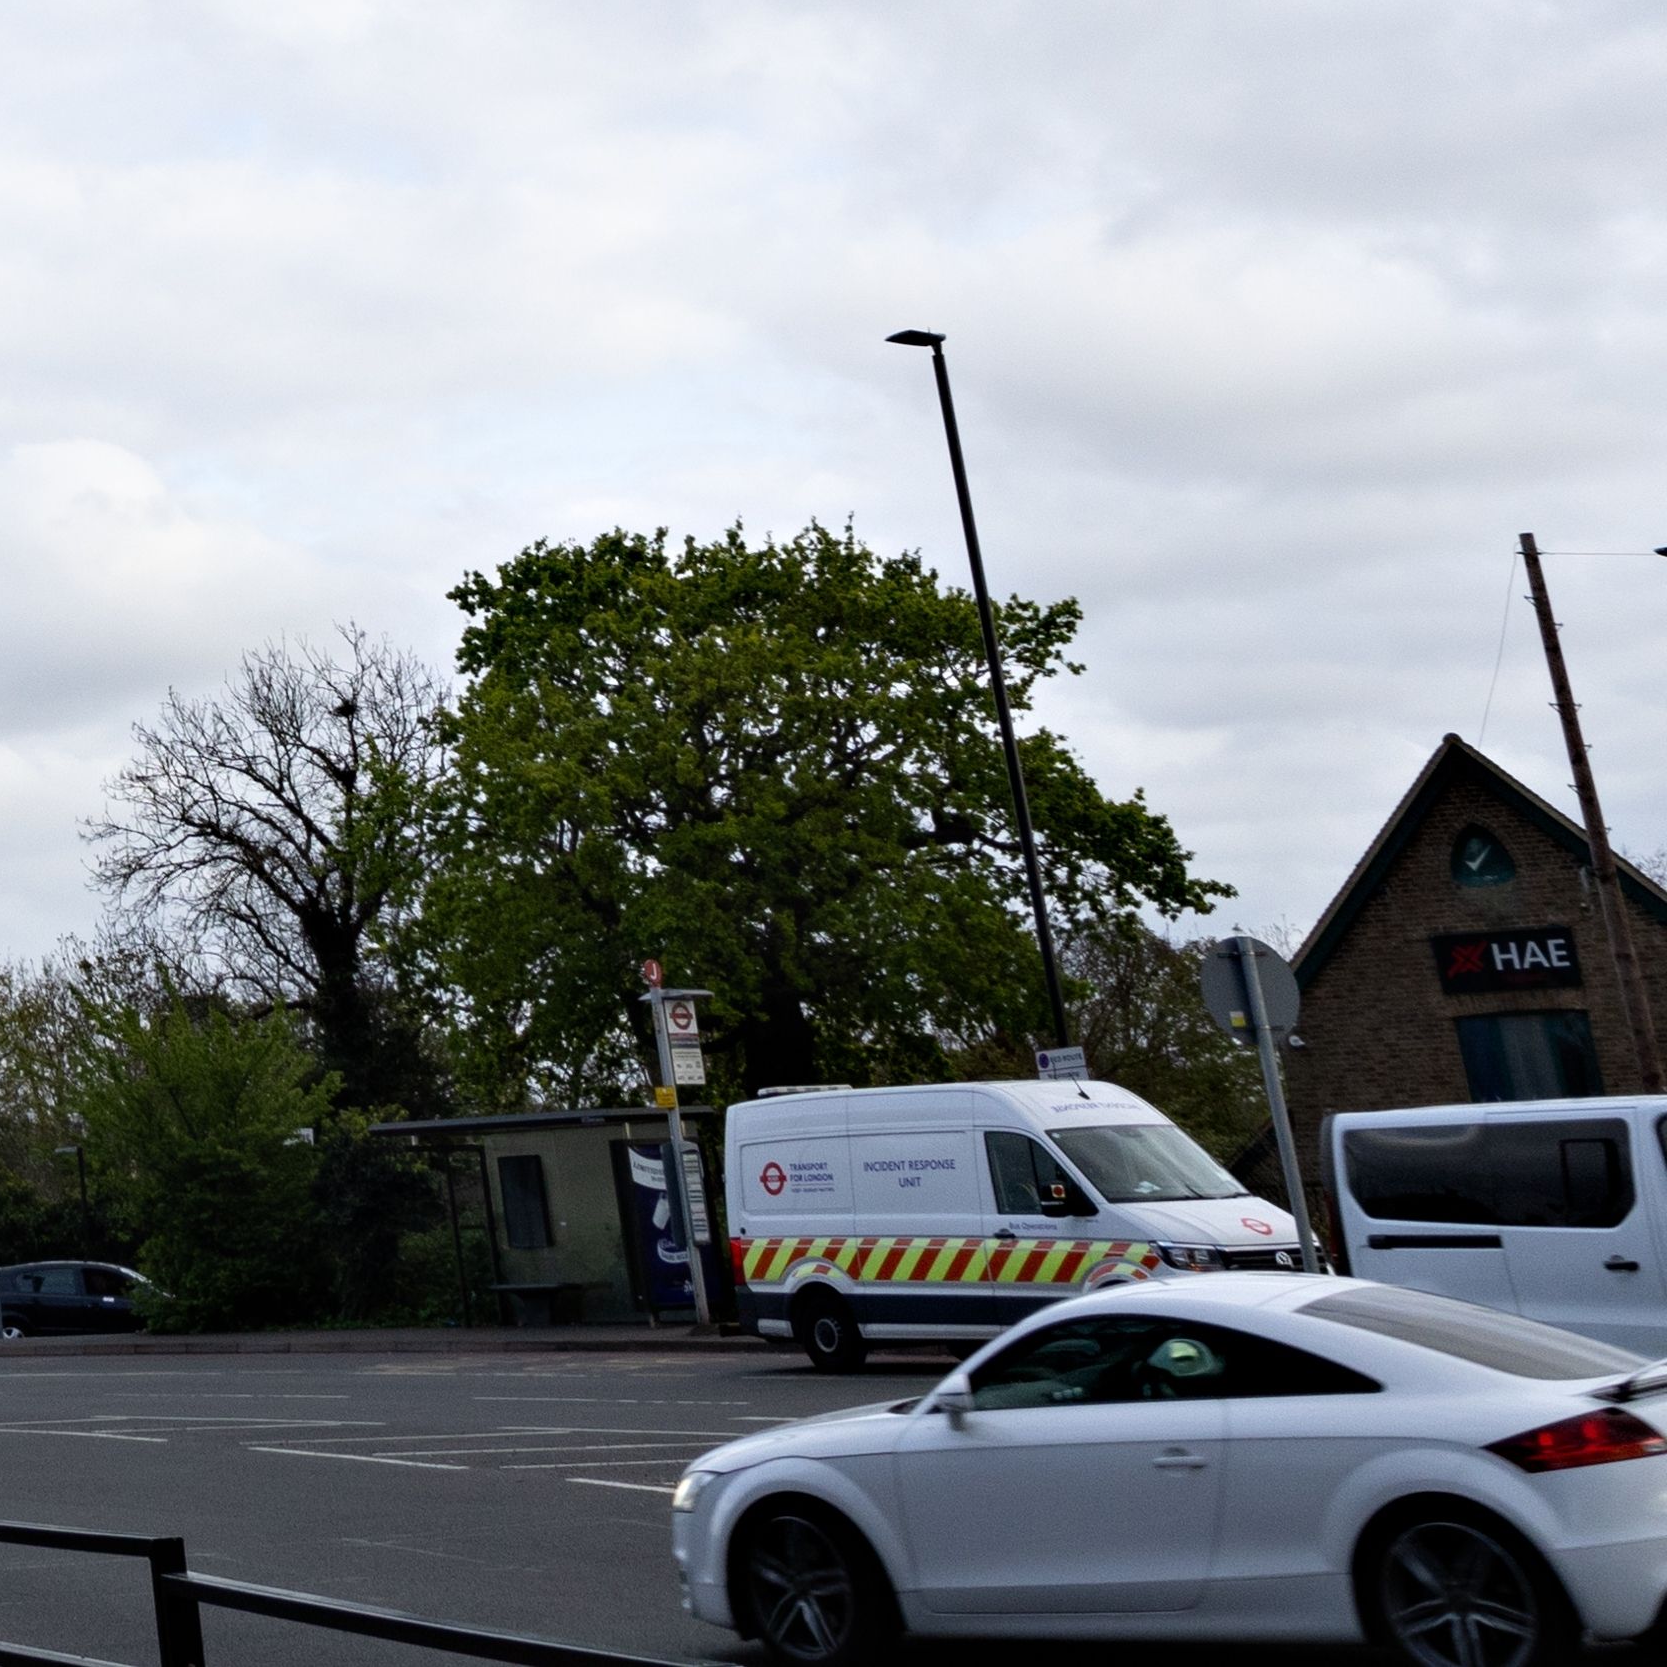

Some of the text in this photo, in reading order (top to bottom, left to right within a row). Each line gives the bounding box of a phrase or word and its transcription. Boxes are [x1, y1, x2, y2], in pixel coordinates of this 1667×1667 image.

[1491, 938, 1571, 971] HAE
[650, 963, 657, 979] J
[789, 1162, 827, 1171] TRANSPORT
[863, 1159, 956, 1173] INCIDENT RESPONSE
[790, 1173, 833, 1182] FOR LONDON
[898, 1176, 922, 1188] UNIT
[1009, 1222, 1020, 1230] Bus
